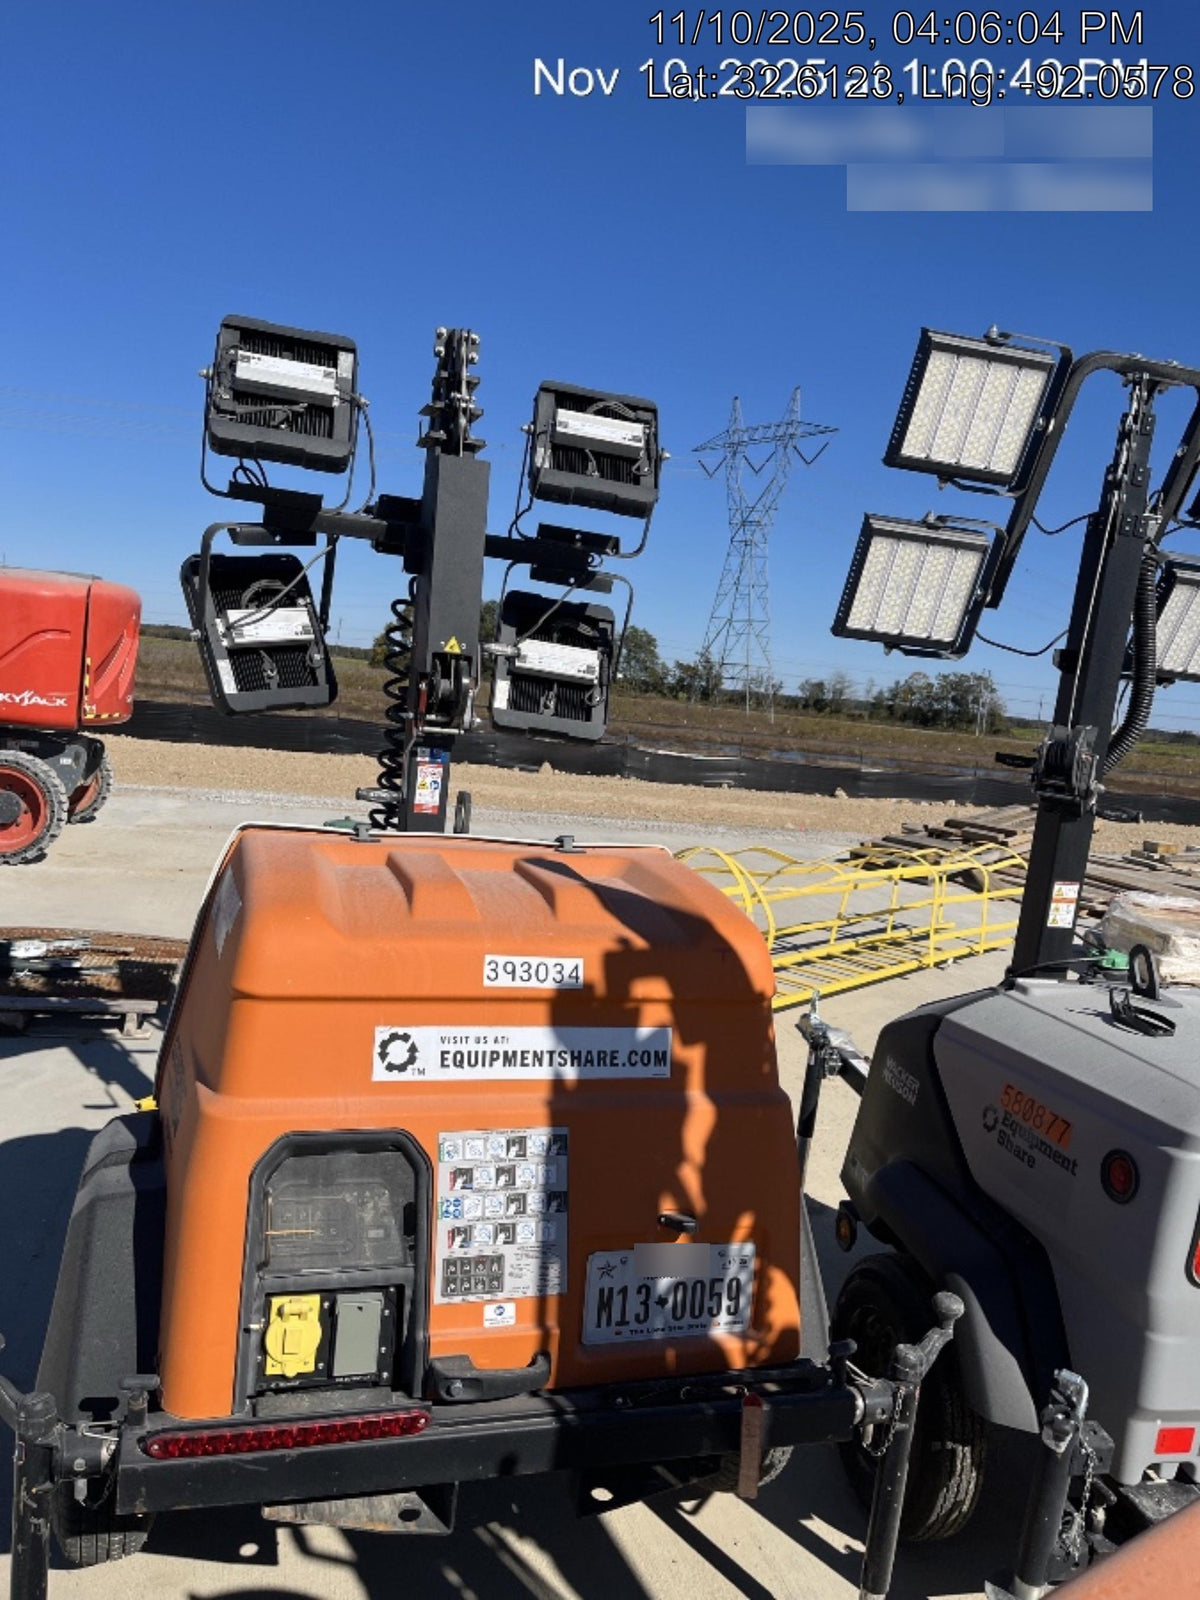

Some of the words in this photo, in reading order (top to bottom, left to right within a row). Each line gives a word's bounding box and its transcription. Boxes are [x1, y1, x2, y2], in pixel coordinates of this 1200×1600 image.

[0, 690, 68, 706] KYJACK
[486, 960, 581, 984] 393034
[440, 1035, 470, 1045] VISIT
[474, 1035, 488, 1045] US
[440, 1049, 668, 1069] EQUIPMENTSHARE.COM
[1001, 1084, 1072, 1145] 580877
[997, 1129, 1036, 1169] Share
[1001, 1109, 1078, 1176] Equipment
